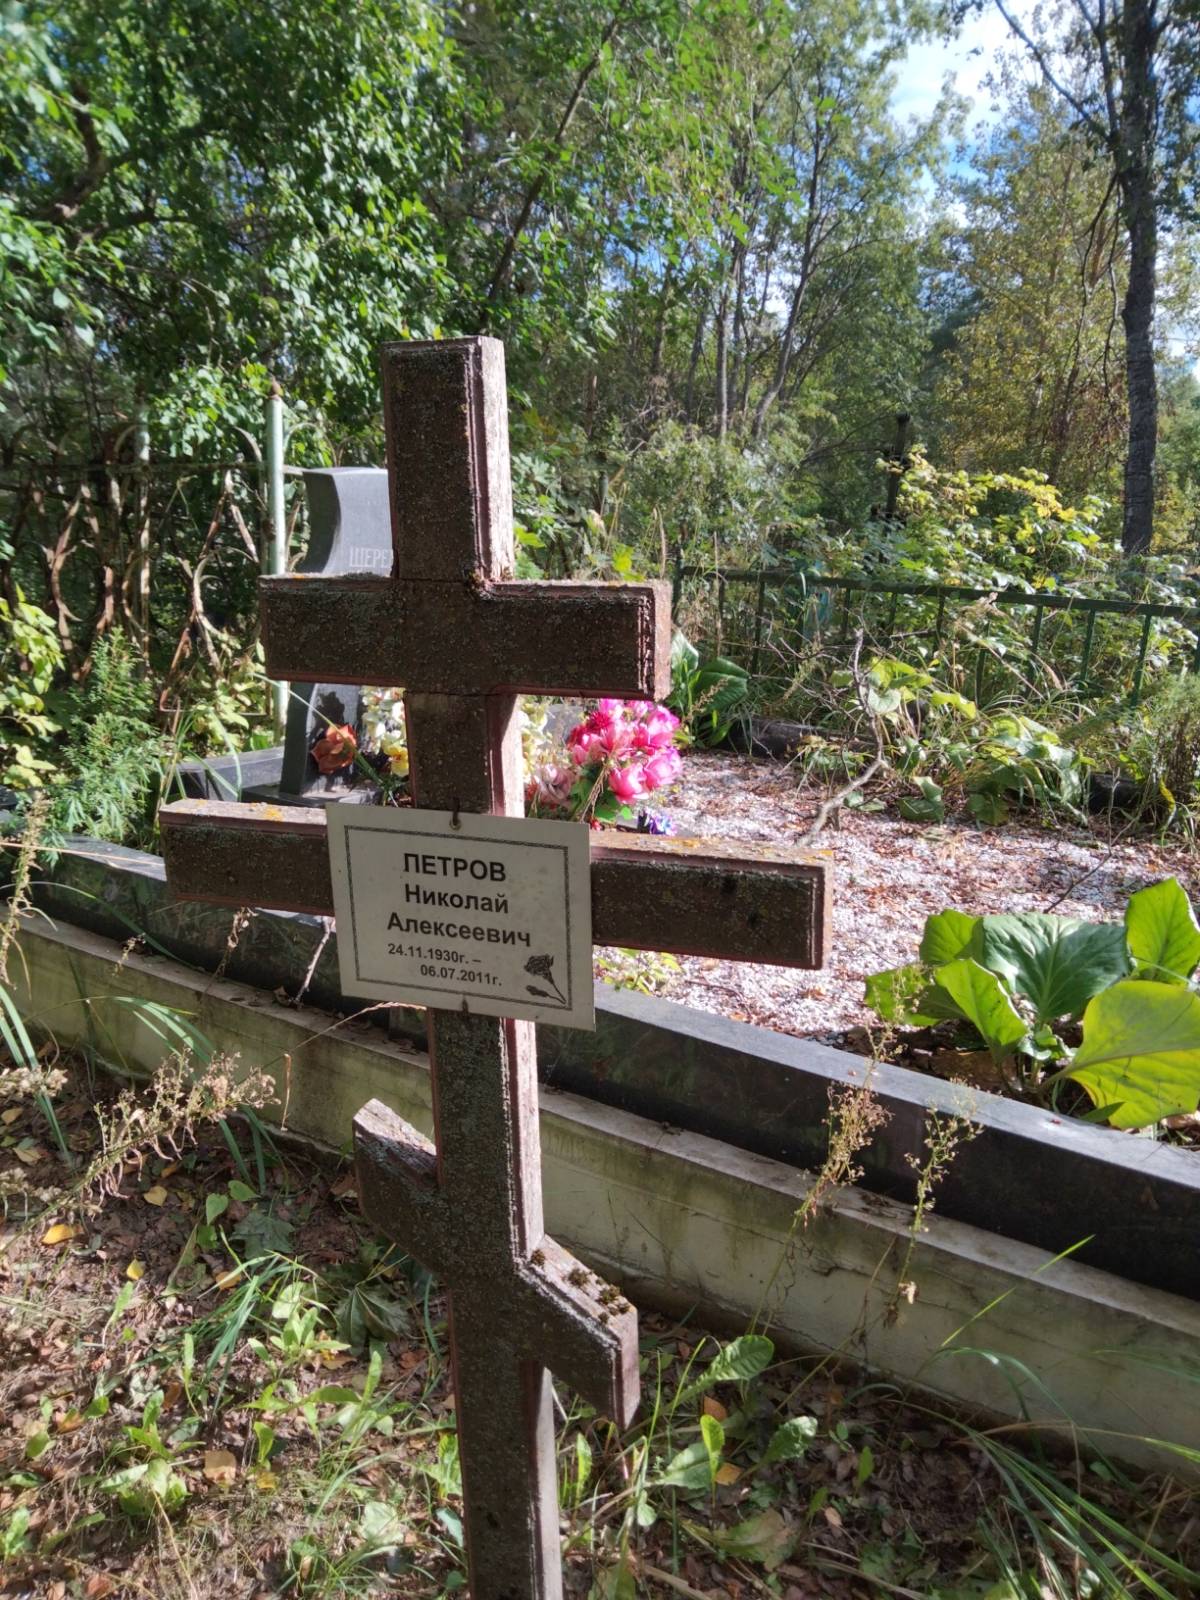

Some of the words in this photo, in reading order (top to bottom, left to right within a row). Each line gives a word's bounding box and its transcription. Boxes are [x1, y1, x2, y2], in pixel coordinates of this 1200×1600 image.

[403, 852, 507, 883] ПЕТРОВ
[404, 883, 509, 915] Николай
[386, 911, 532, 948] Алексеевич
[387, 943, 470, 965] 24.11.1930г.
[419, 964, 503, 987] 06.07.2011г.
